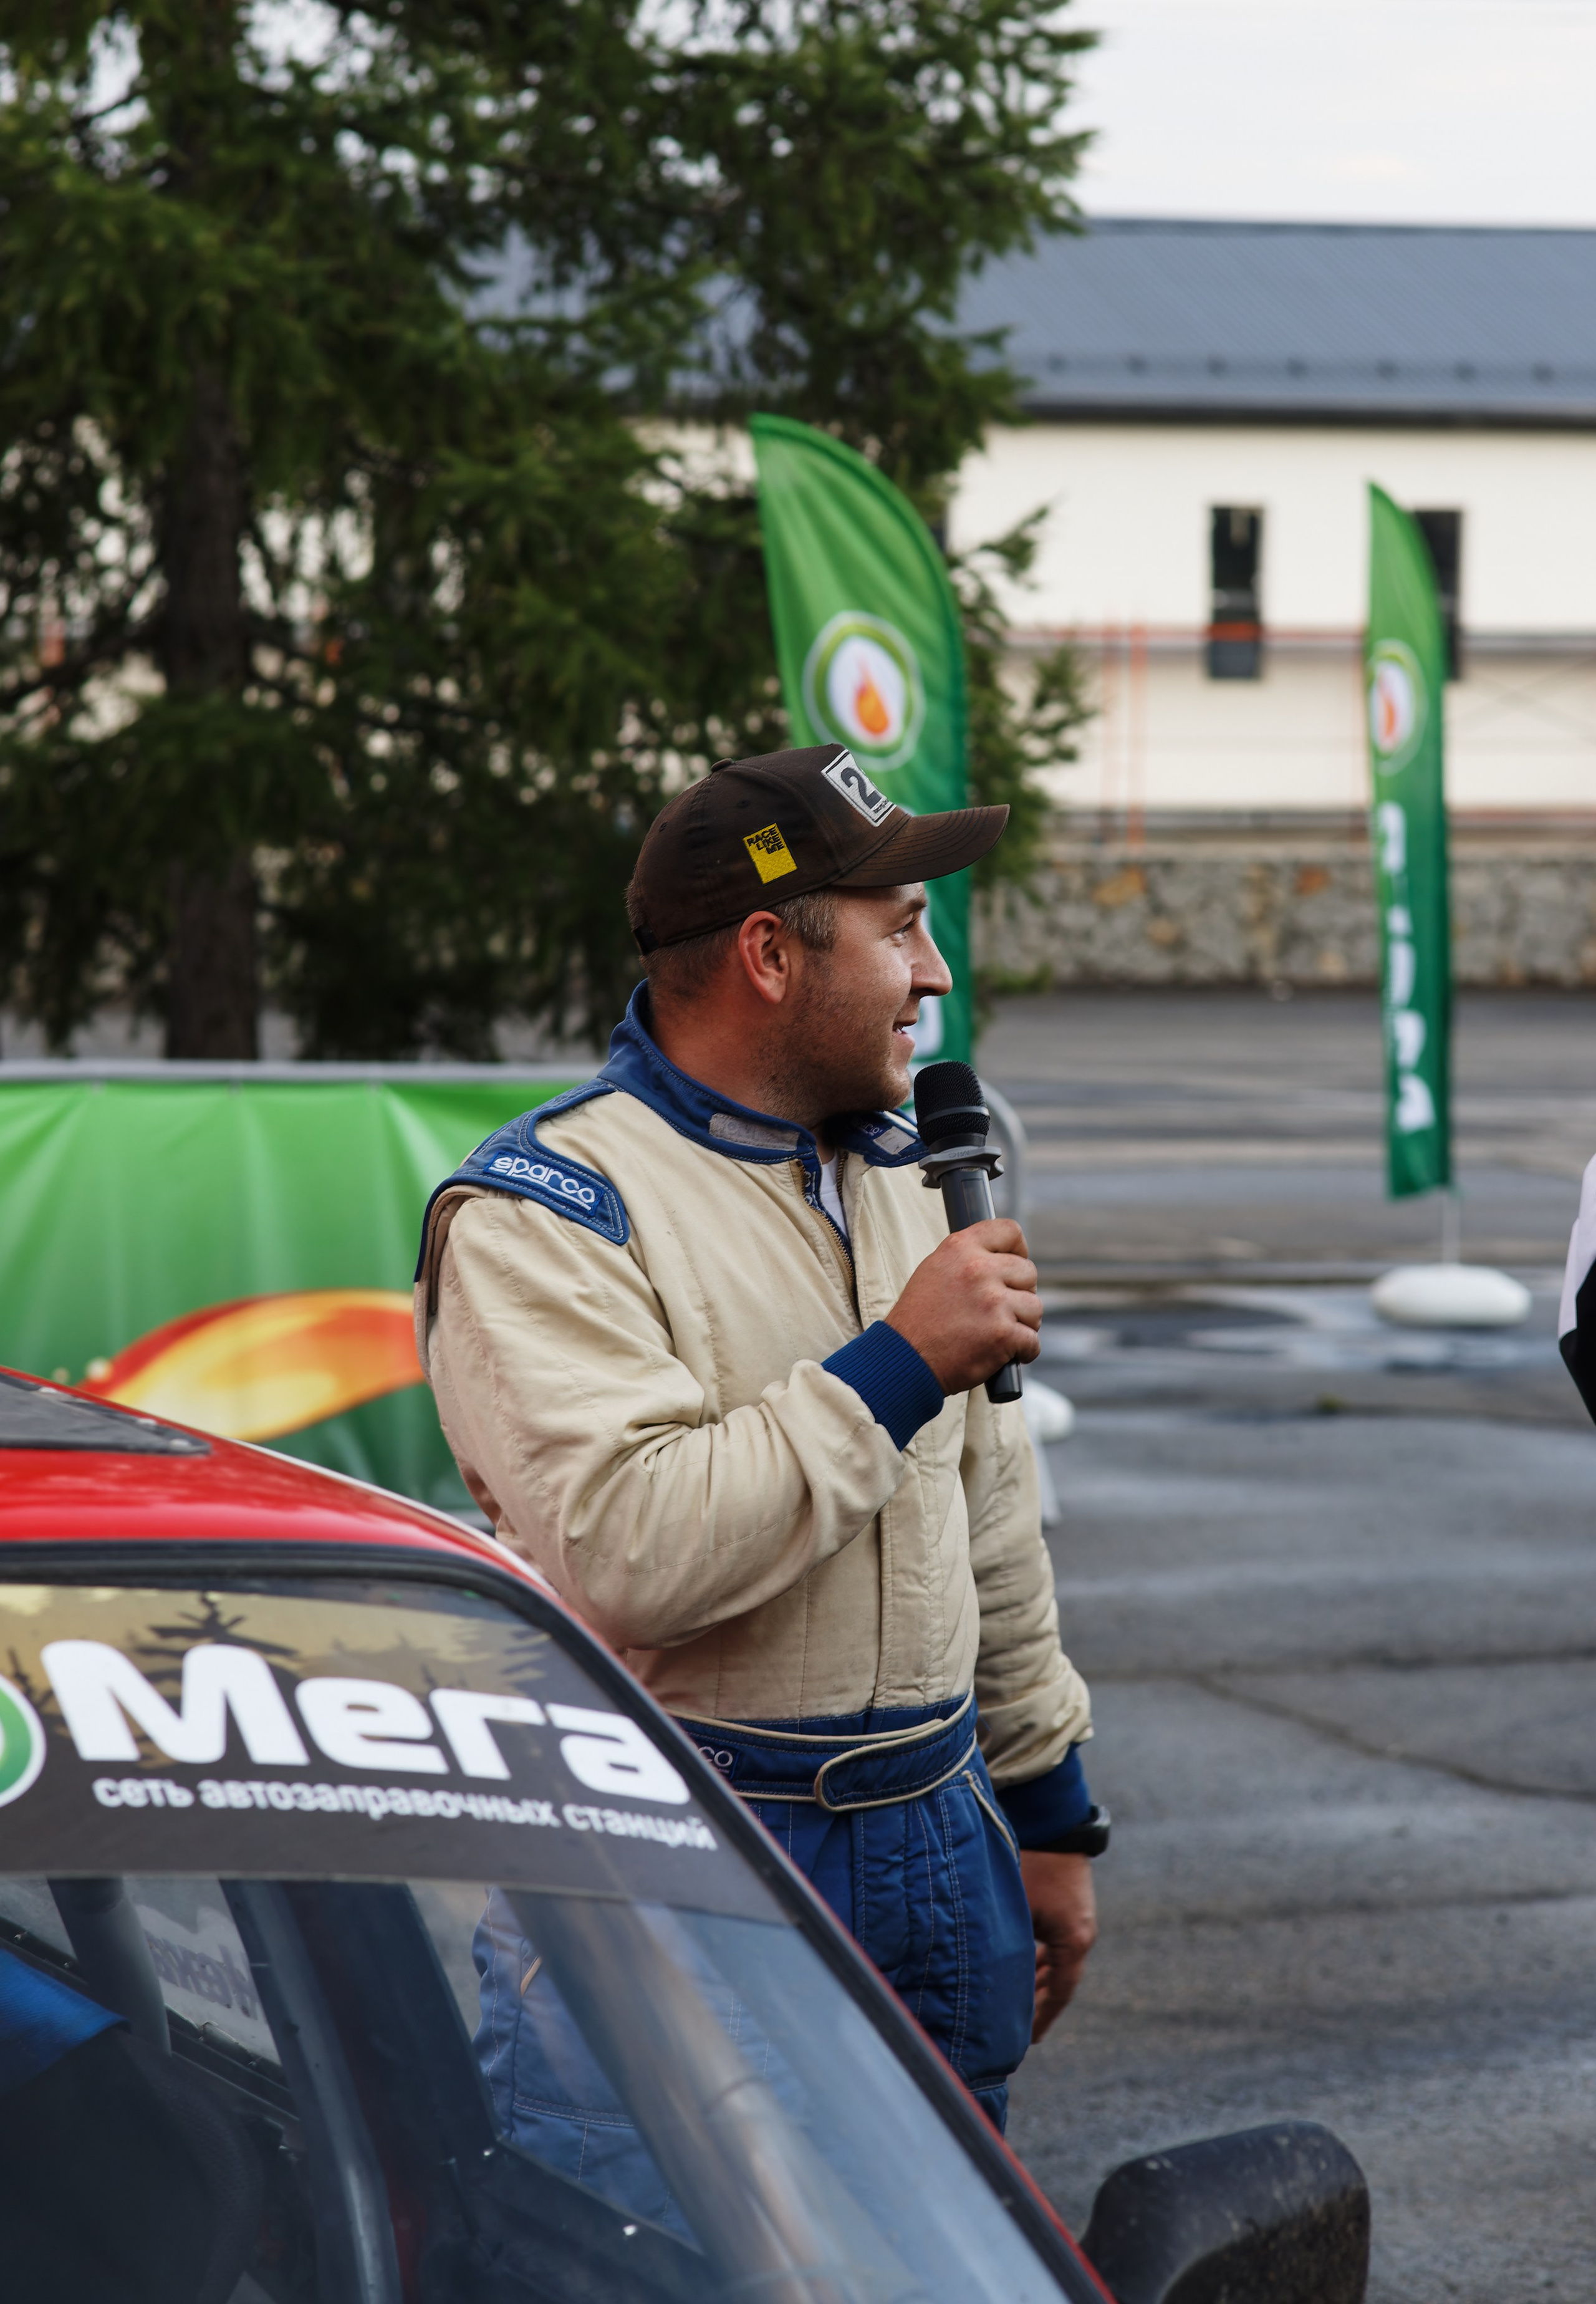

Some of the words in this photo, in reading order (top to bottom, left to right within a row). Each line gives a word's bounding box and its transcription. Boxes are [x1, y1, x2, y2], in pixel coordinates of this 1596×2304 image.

[841, 768, 883, 809] 2
[747, 826, 777, 847] RACE
[756, 833, 781, 851] LIKE
[766, 841, 784, 854] ME
[493, 1156, 595, 1204] sparco
[41, 1639, 690, 1804] Мега
[92, 1778, 195, 1808] сеть
[197, 1779, 561, 1828] автозаправочных
[562, 1803, 718, 1851] станций
